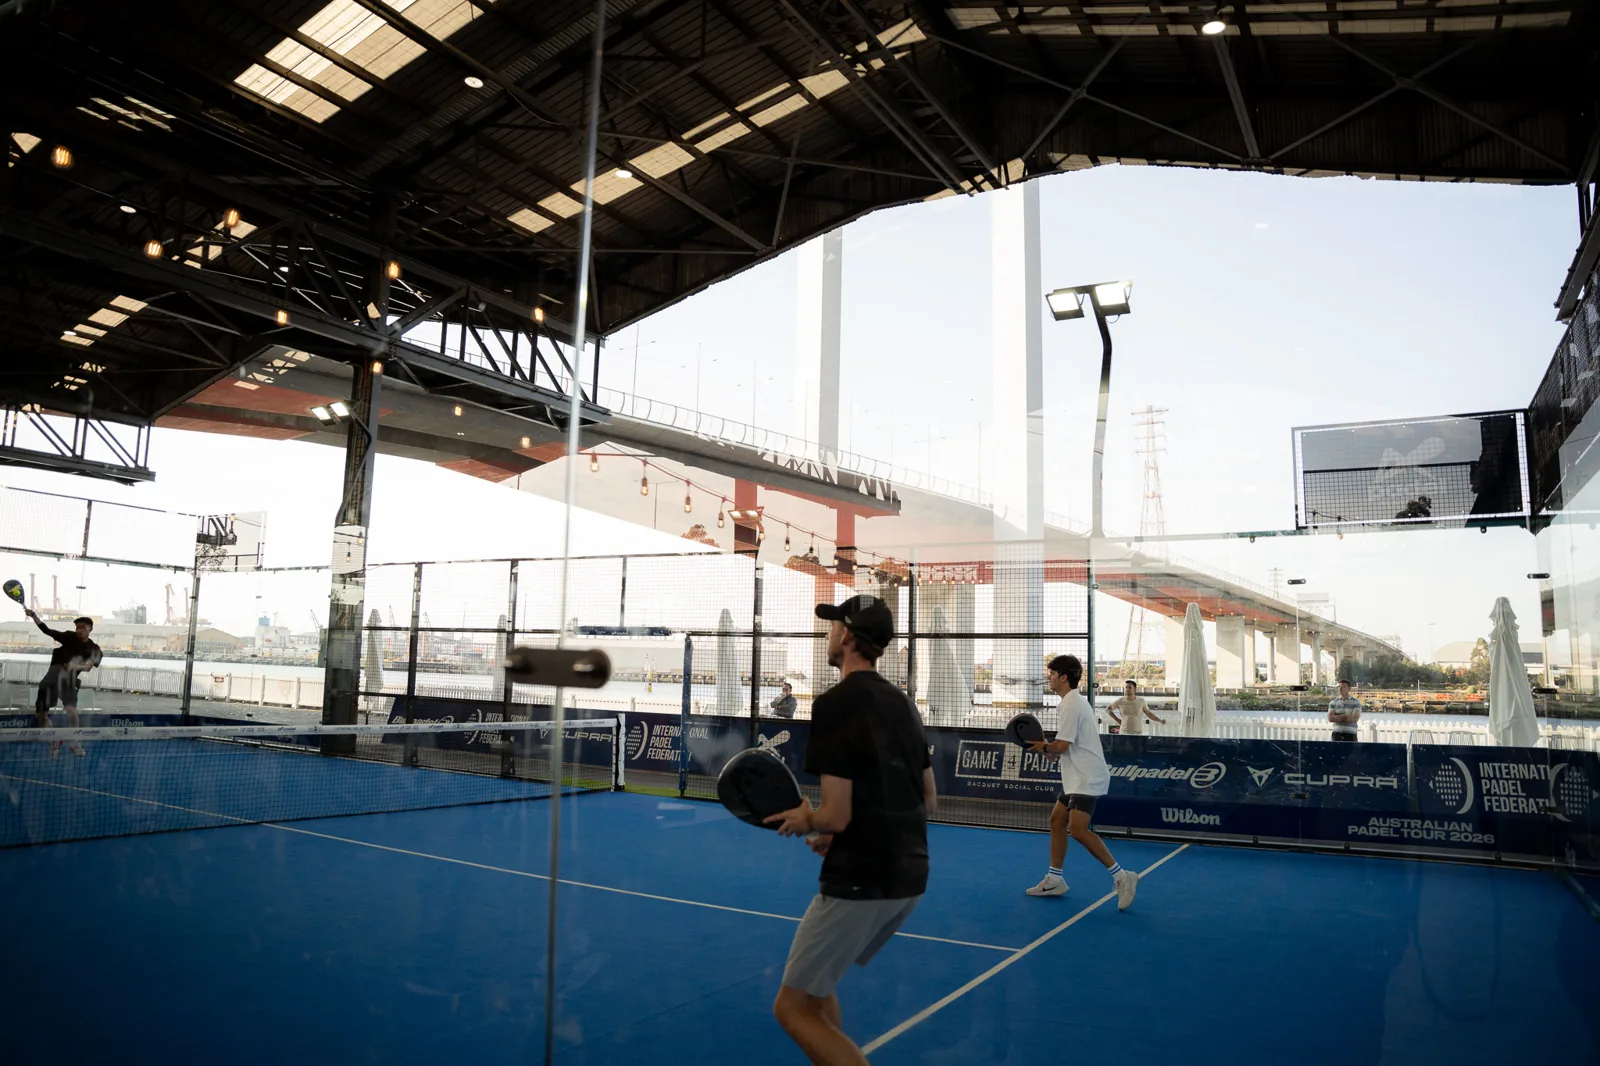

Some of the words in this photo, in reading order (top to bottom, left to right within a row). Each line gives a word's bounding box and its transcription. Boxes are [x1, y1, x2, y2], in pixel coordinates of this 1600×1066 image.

[652, 725, 708, 739] INTERNONAL
[650, 736, 672, 749] PADEL
[962, 749, 999, 770] GAME
[1007, 754, 1016, 769] 4
[1479, 762, 1551, 780] INTERNATI
[1004, 783, 1031, 791] SOCIAL
[1284, 773, 1398, 789] CUPRA
[1481, 779, 1526, 796] PADEL
[1160, 807, 1221, 825] Wilson
[1368, 816, 1473, 832] AUSTRALIAN
[1348, 825, 1399, 838] PADEL
[1400, 828, 1446, 841] TOUR
[1450, 833, 1495, 844] 2026
